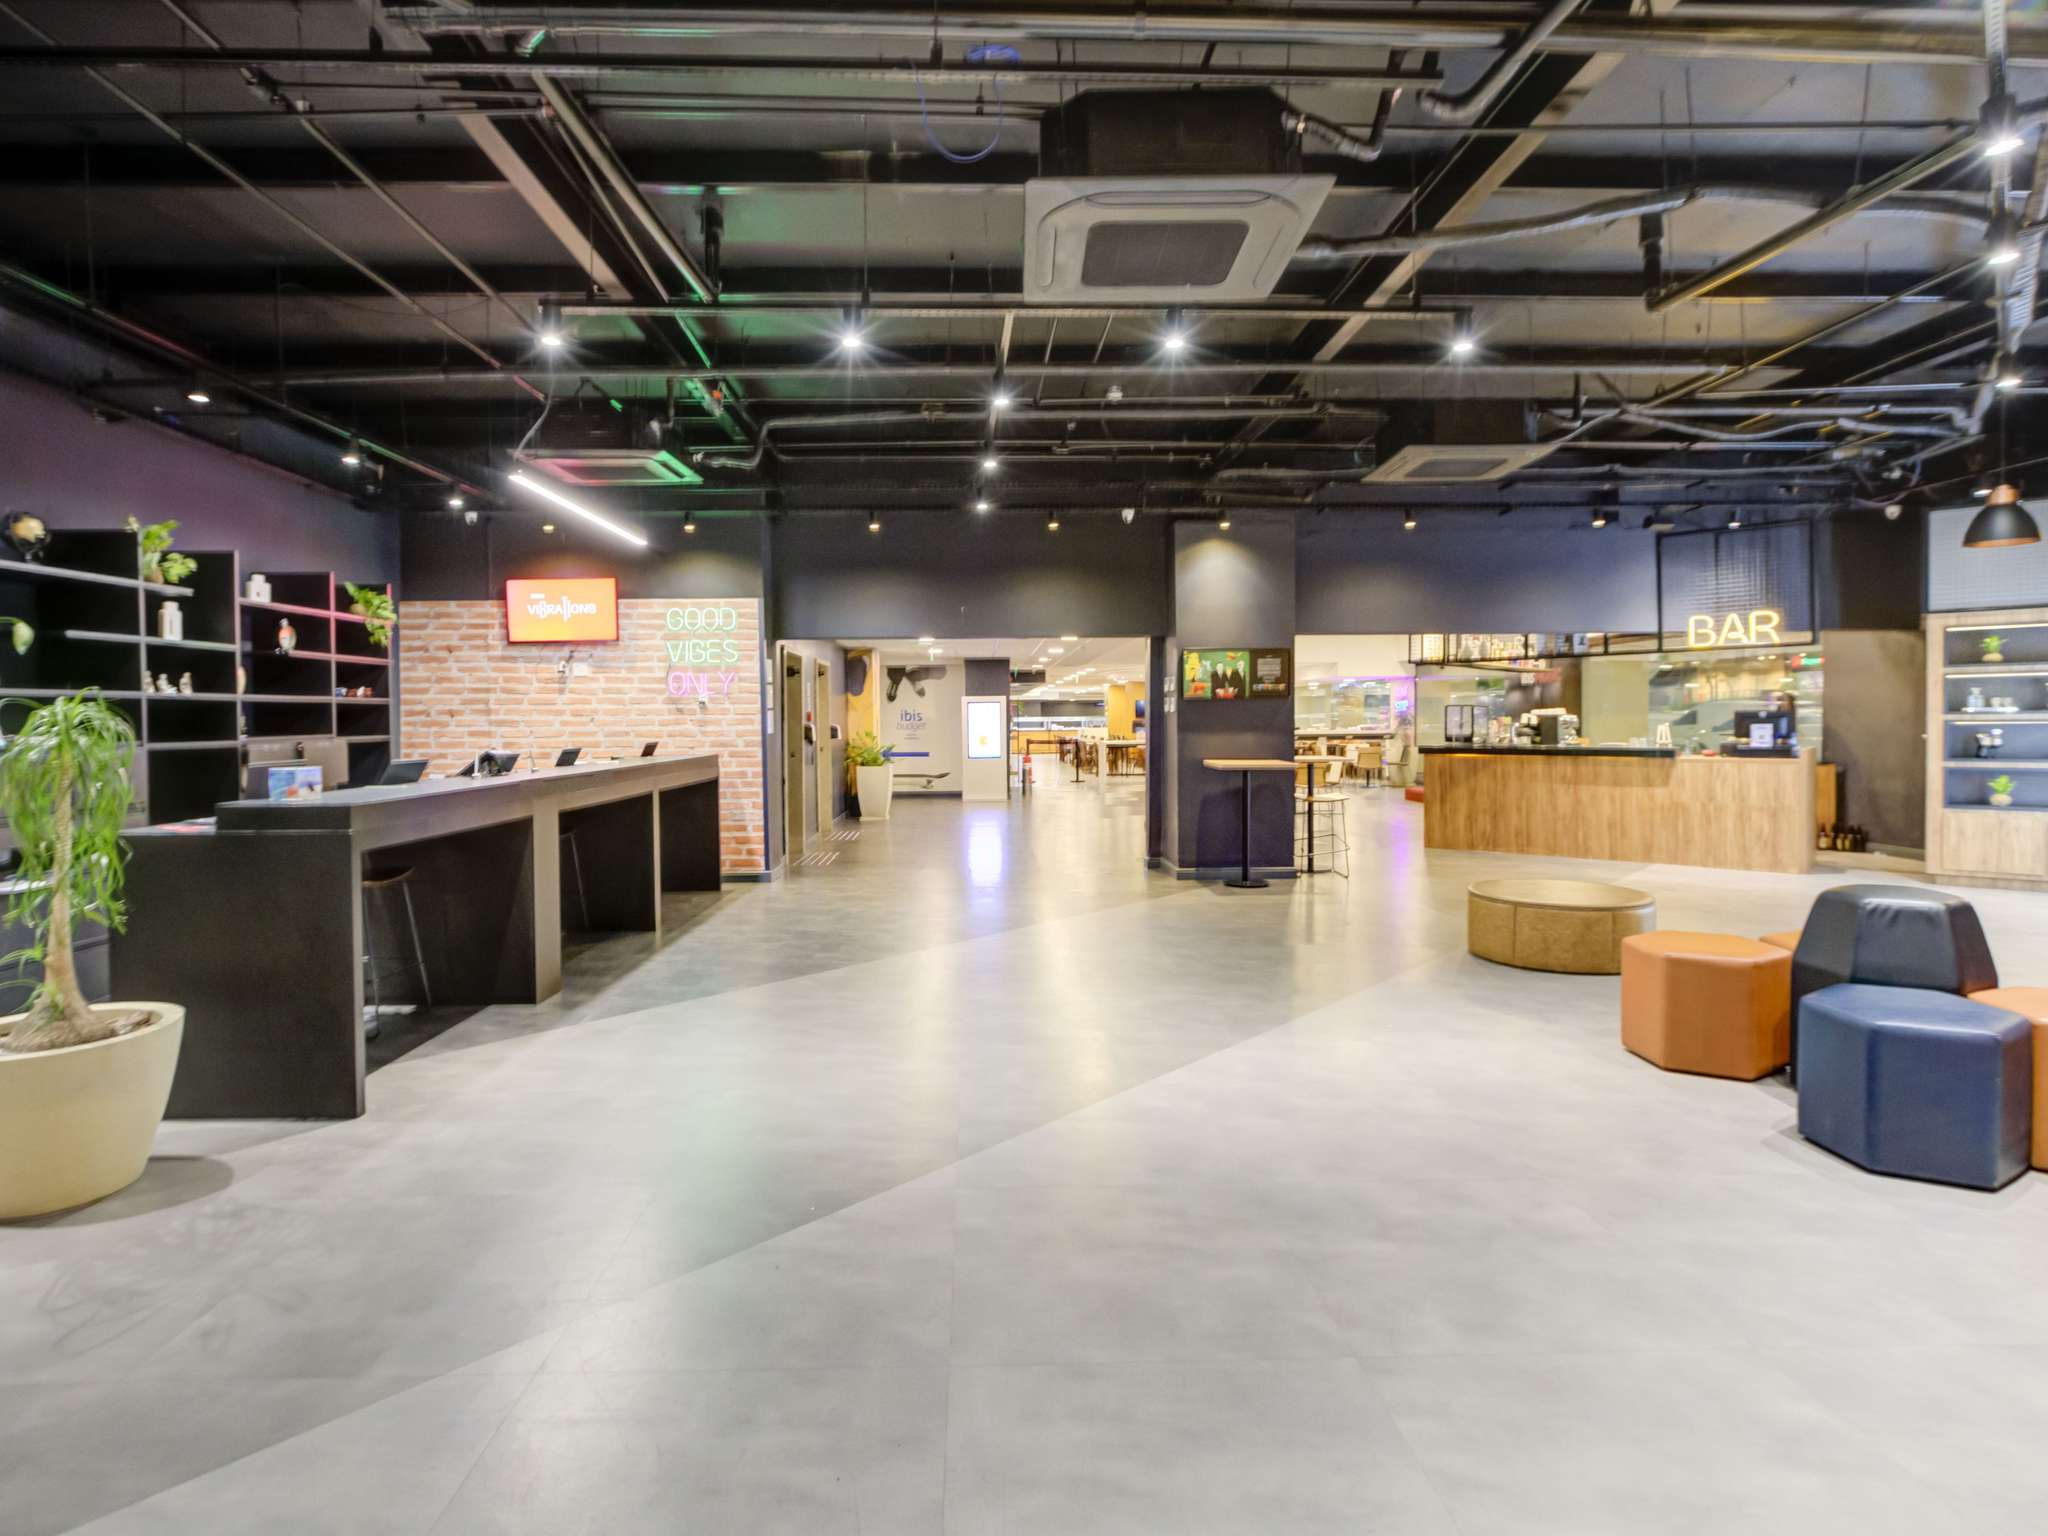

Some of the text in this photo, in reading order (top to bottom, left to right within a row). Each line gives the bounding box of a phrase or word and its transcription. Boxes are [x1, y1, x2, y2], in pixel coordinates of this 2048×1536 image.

[666, 607, 737, 631] GOOD
[1687, 609, 1782, 648] BAR
[666, 638, 739, 663] VIBES
[669, 671, 736, 697] ONLY
[900, 709, 922, 722] ibis
